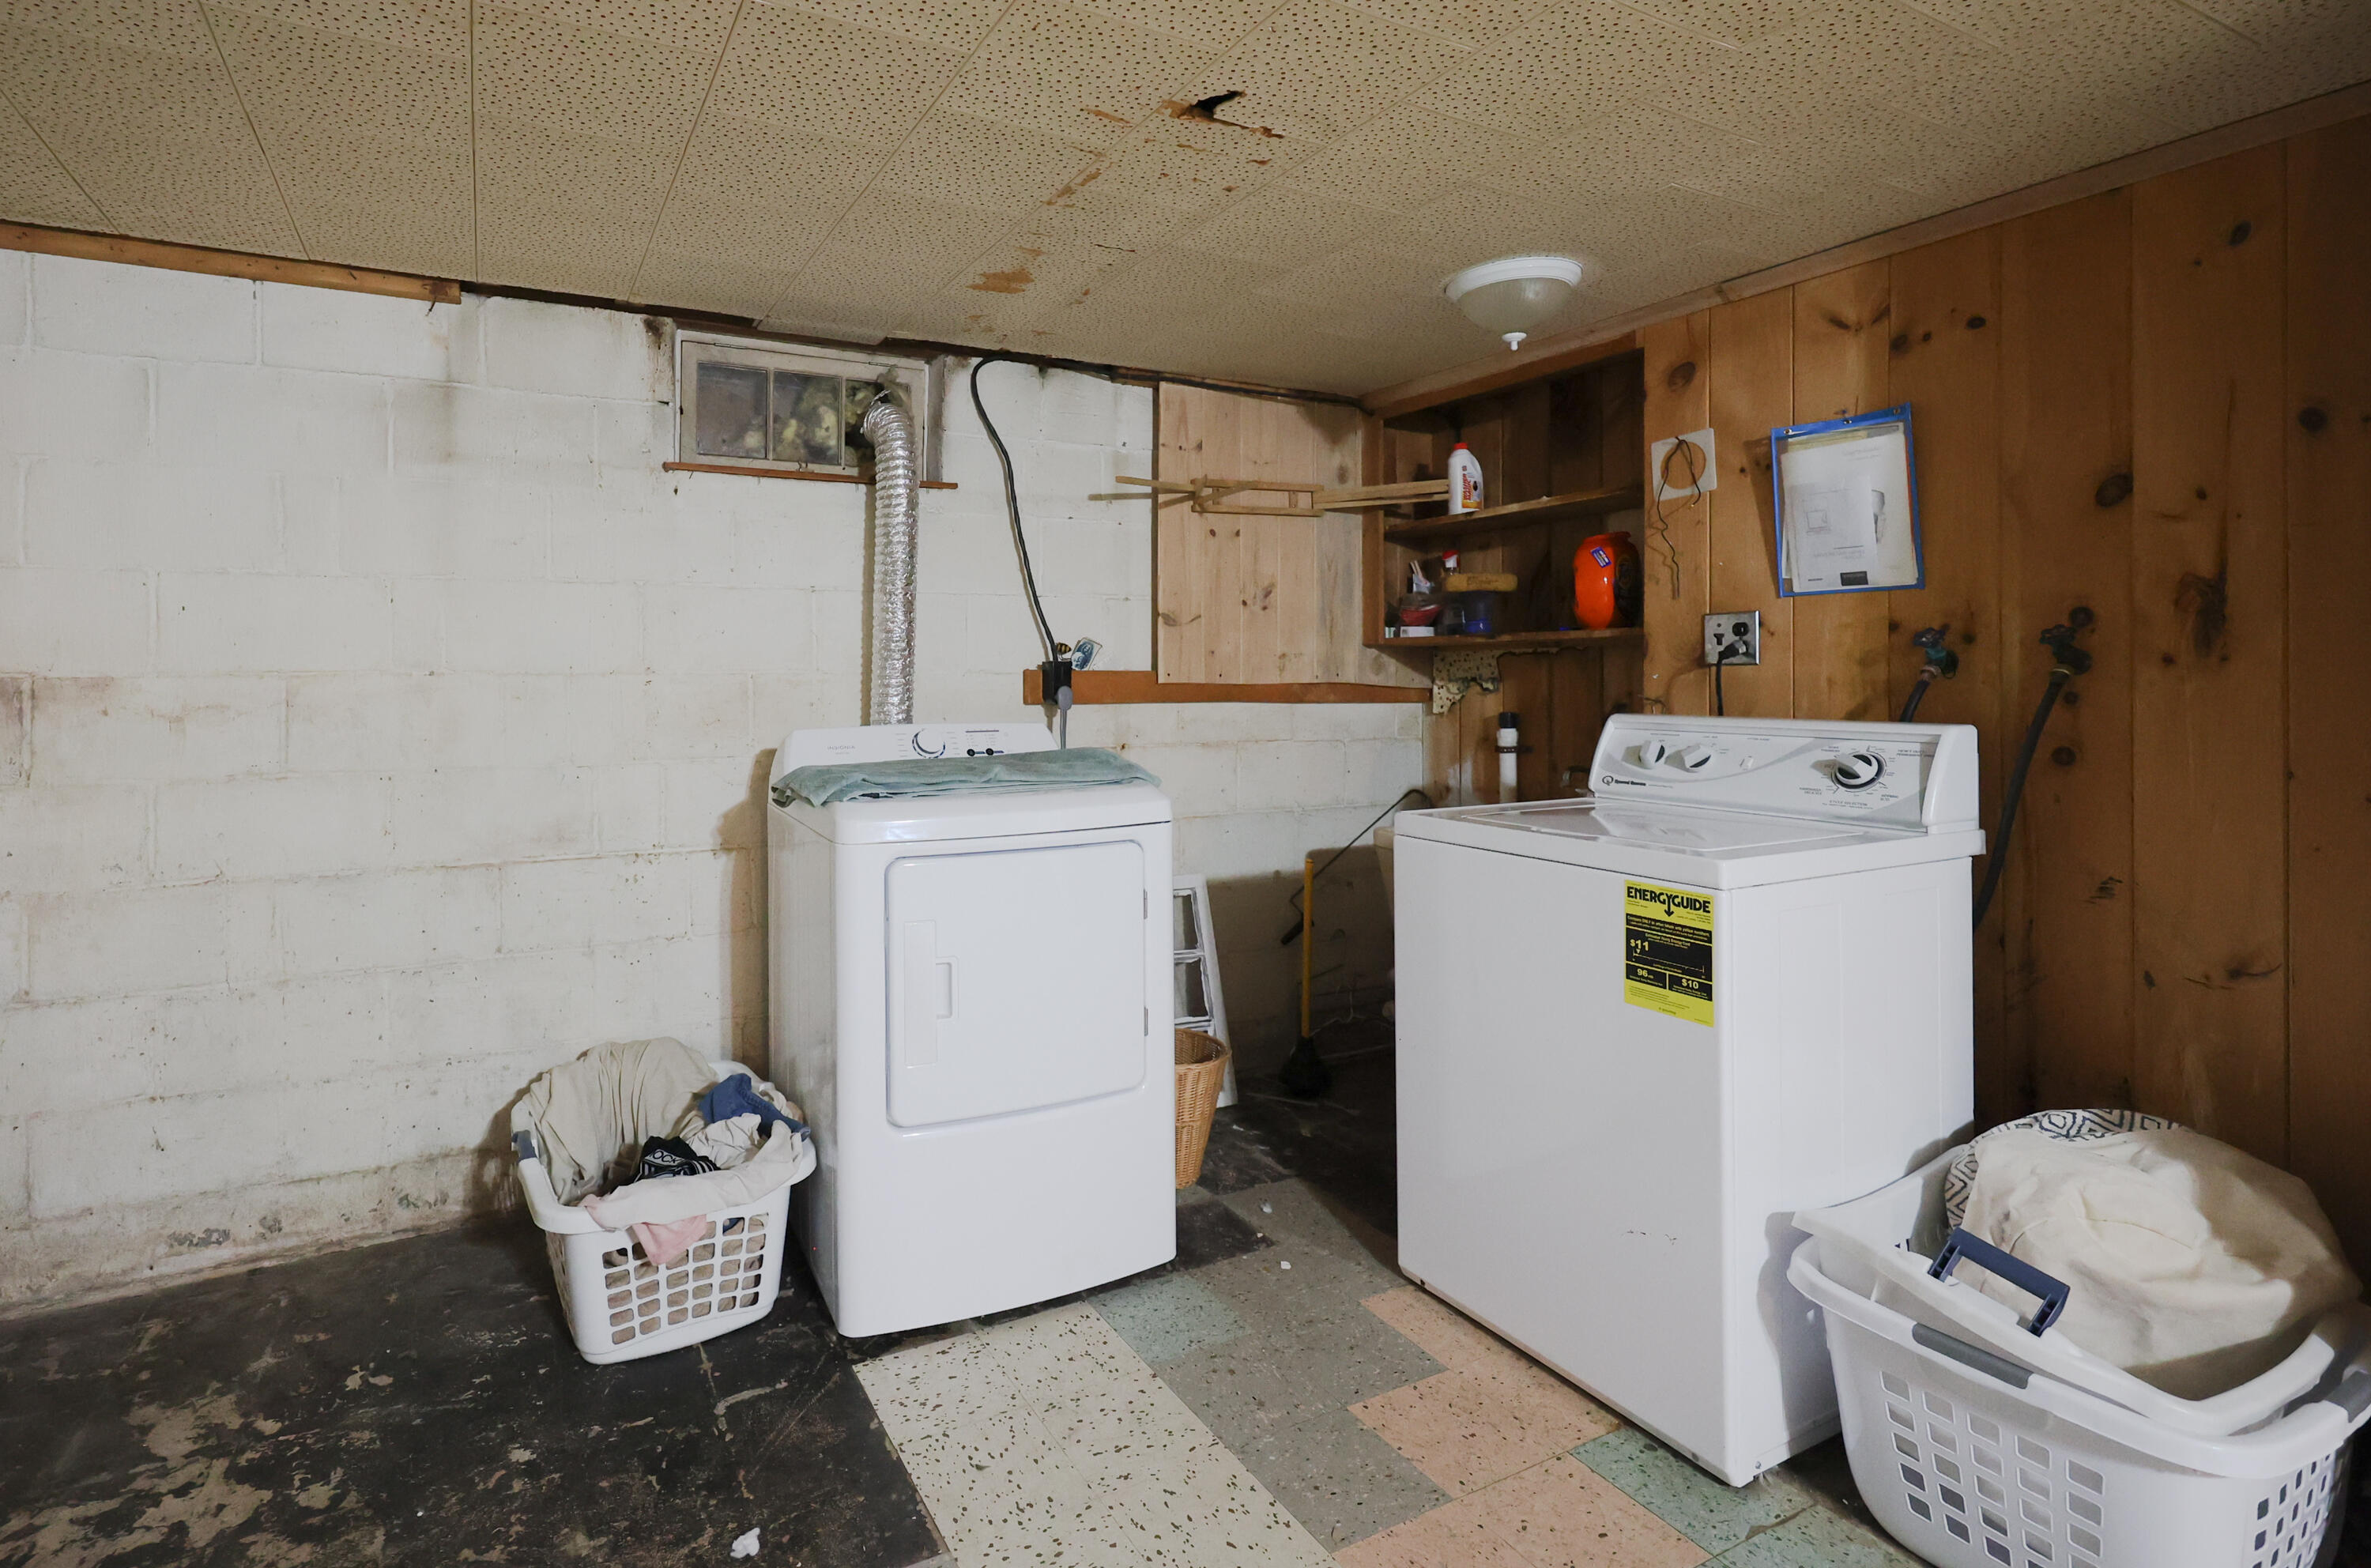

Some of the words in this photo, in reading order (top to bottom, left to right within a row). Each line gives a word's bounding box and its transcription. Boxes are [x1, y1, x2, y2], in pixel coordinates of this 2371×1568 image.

[1627, 886, 1711, 914] ENERGYGUIDE
[1630, 939, 1649, 952] $11
[1637, 968, 1648, 978] 96
[1681, 978, 1699, 989] $10
